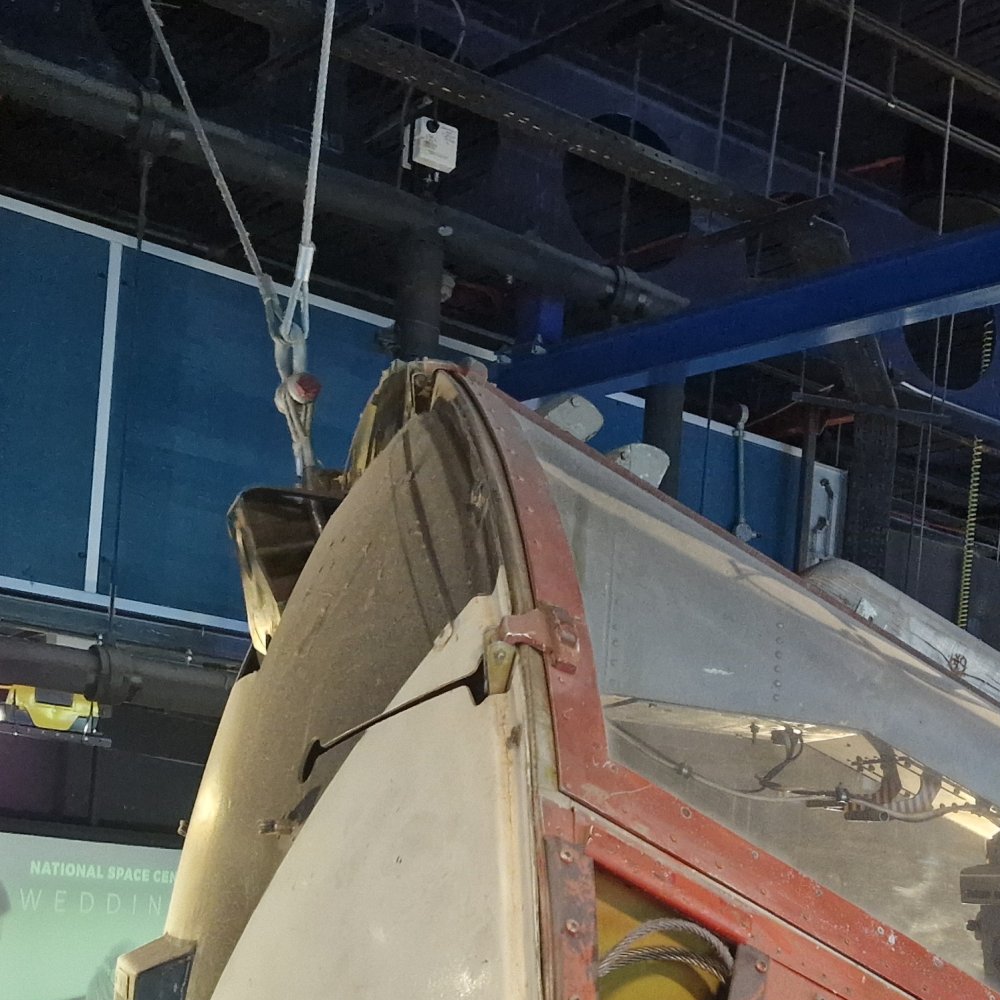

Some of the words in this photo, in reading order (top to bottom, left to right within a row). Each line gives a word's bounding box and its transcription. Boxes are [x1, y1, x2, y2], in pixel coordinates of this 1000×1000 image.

[30, 860, 104, 880] NATIONAL
[107, 866, 150, 882] SPACE
[19, 887, 162, 916] WEDDIN
